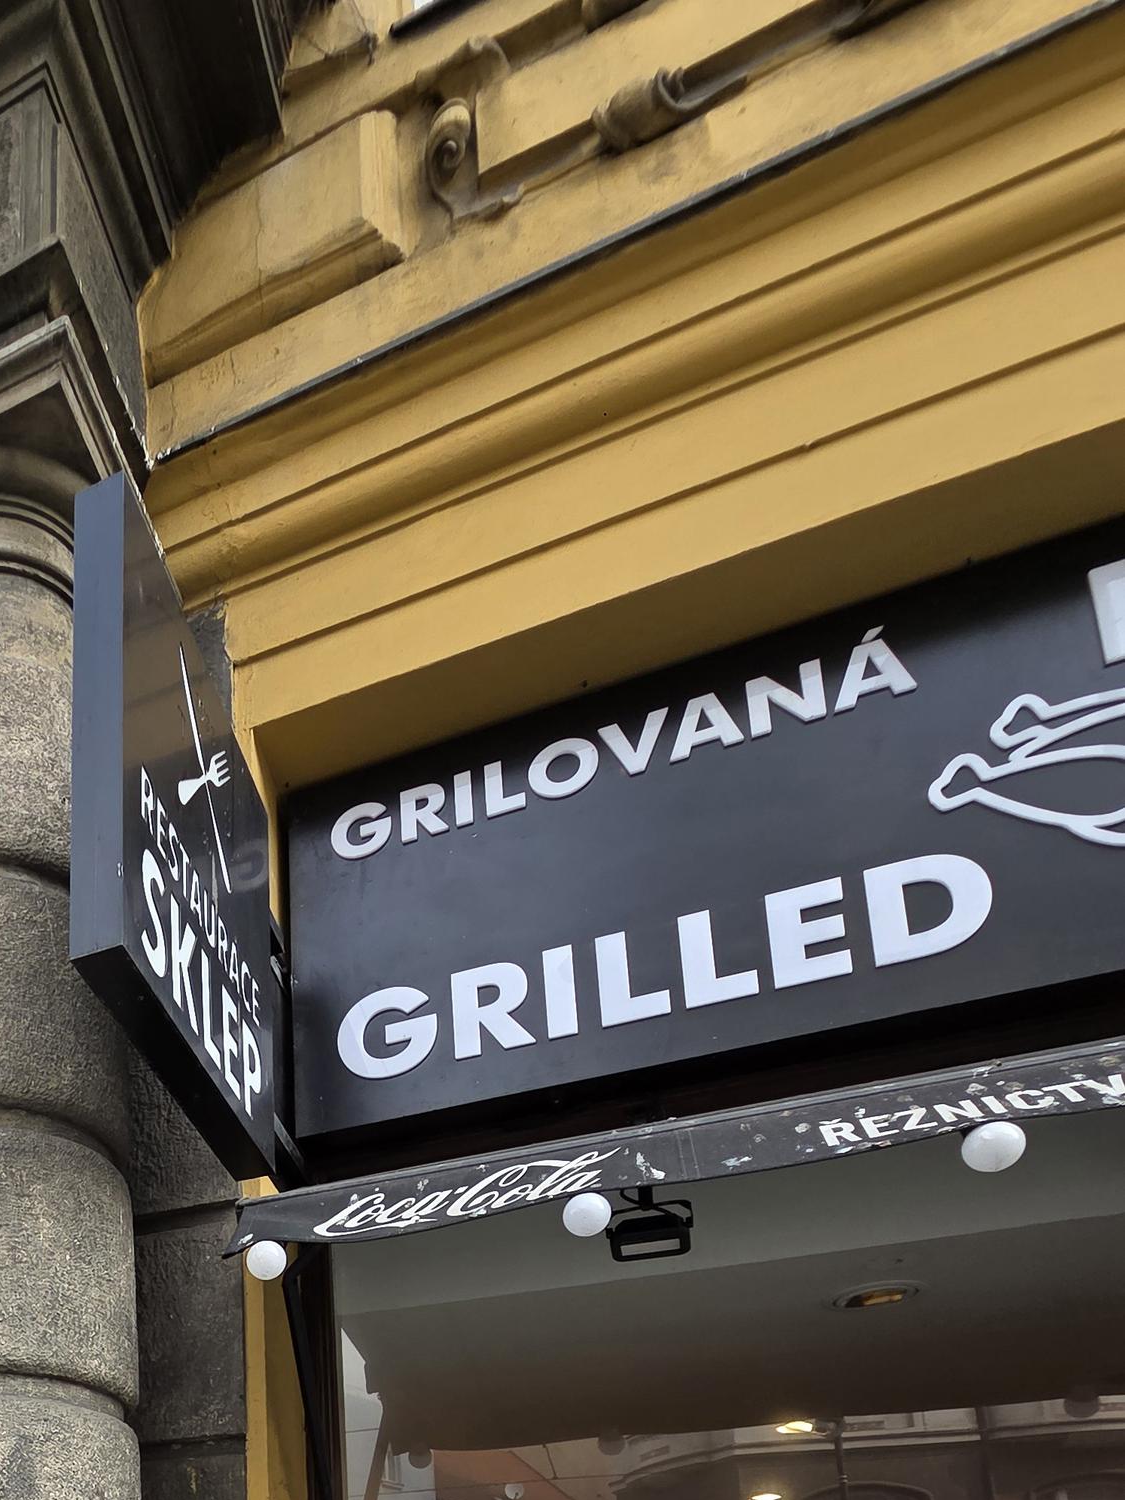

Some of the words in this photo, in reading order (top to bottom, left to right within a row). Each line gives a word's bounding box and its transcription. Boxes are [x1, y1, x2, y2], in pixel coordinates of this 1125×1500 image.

[329, 626, 918, 860] GRILOVANÁ
[140, 761, 261, 1027] RESTAURACE
[140, 847, 262, 1119] SKLEP
[336, 852, 994, 1081] GRILLED
